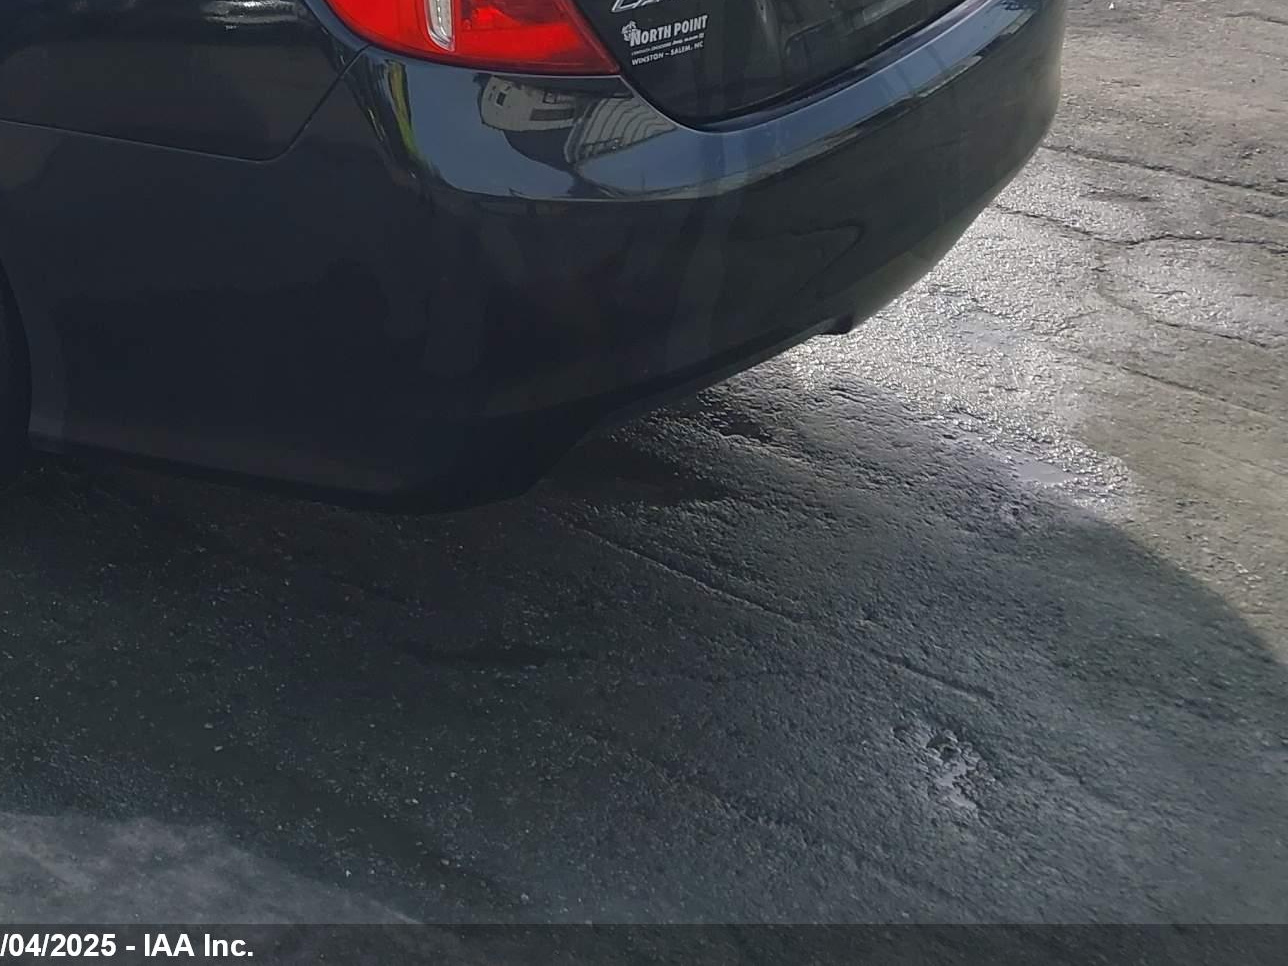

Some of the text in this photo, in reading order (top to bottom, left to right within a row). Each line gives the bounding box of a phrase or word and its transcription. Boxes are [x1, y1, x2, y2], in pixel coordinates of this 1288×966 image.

[629, 24, 672, 47] NORTH
[673, 14, 708, 37] POINT
[631, 51, 664, 66] WINSTON
[694, 40, 704, 49] NC
